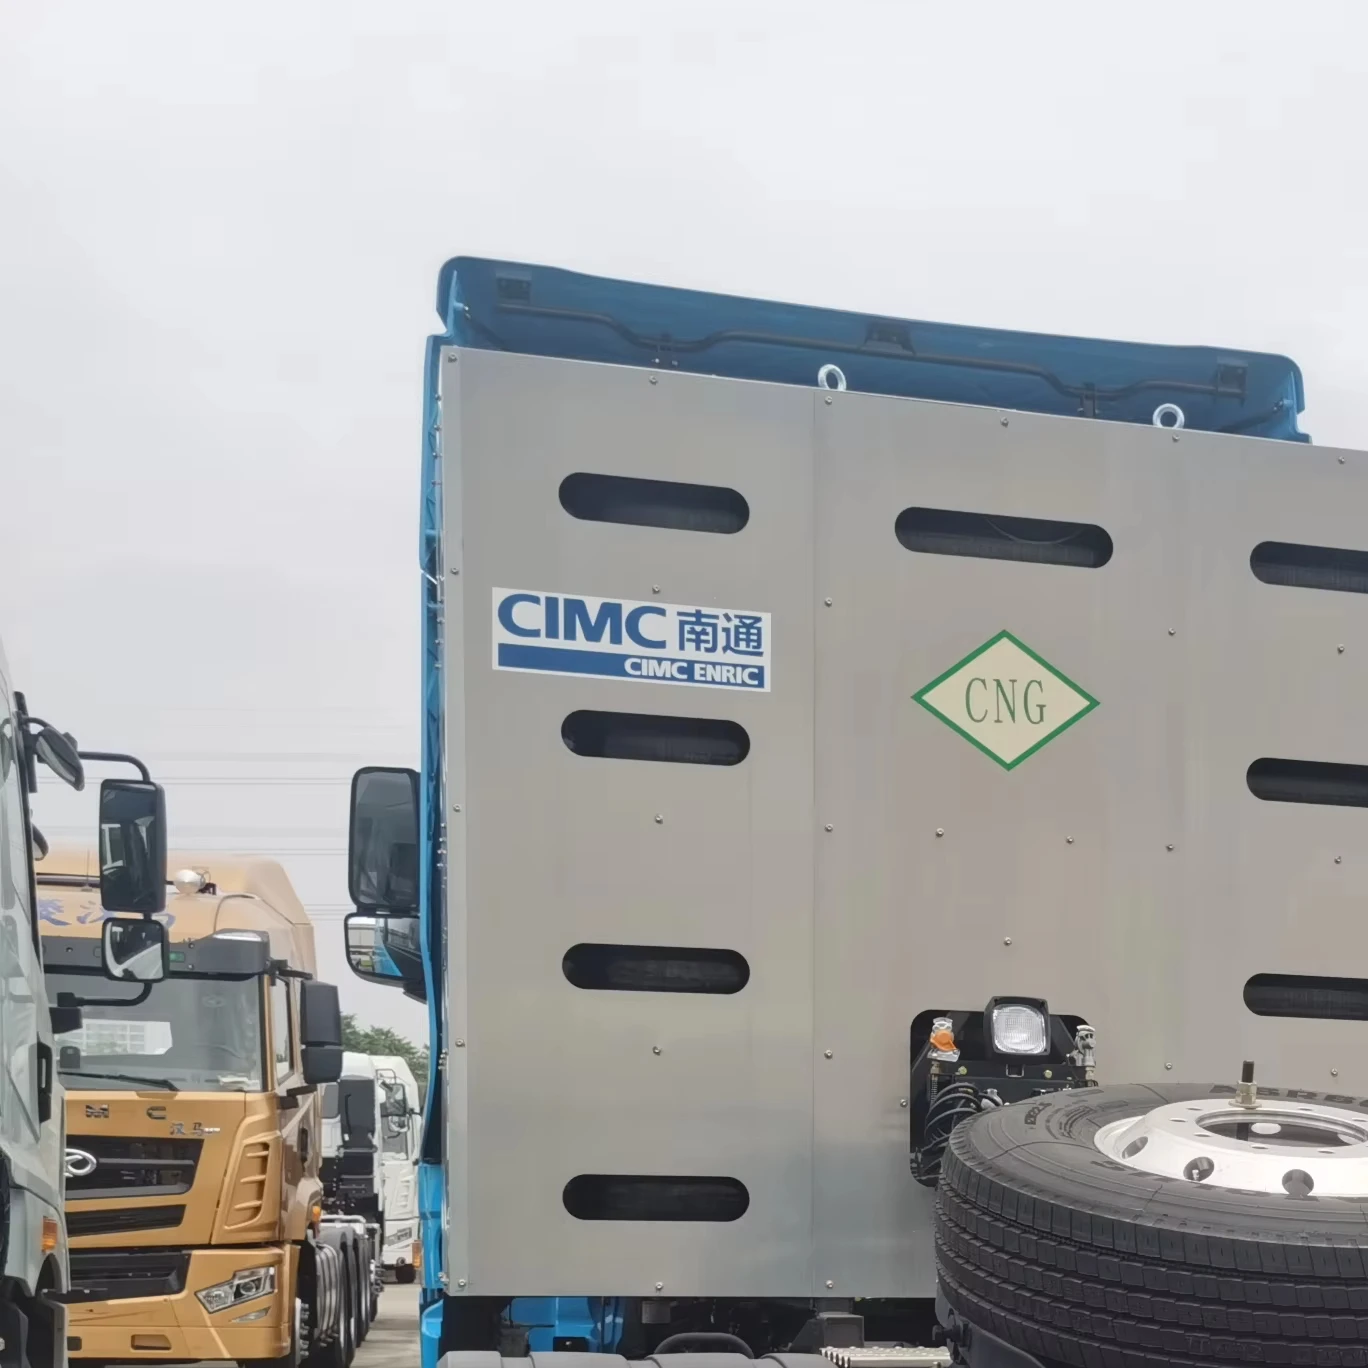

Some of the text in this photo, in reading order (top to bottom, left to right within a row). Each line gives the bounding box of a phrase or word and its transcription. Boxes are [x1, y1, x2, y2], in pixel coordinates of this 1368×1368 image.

[498, 593, 765, 657] CIMC 南通
[624, 657, 759, 685] CIMC ENRIC
[965, 677, 1047, 725] CNG
